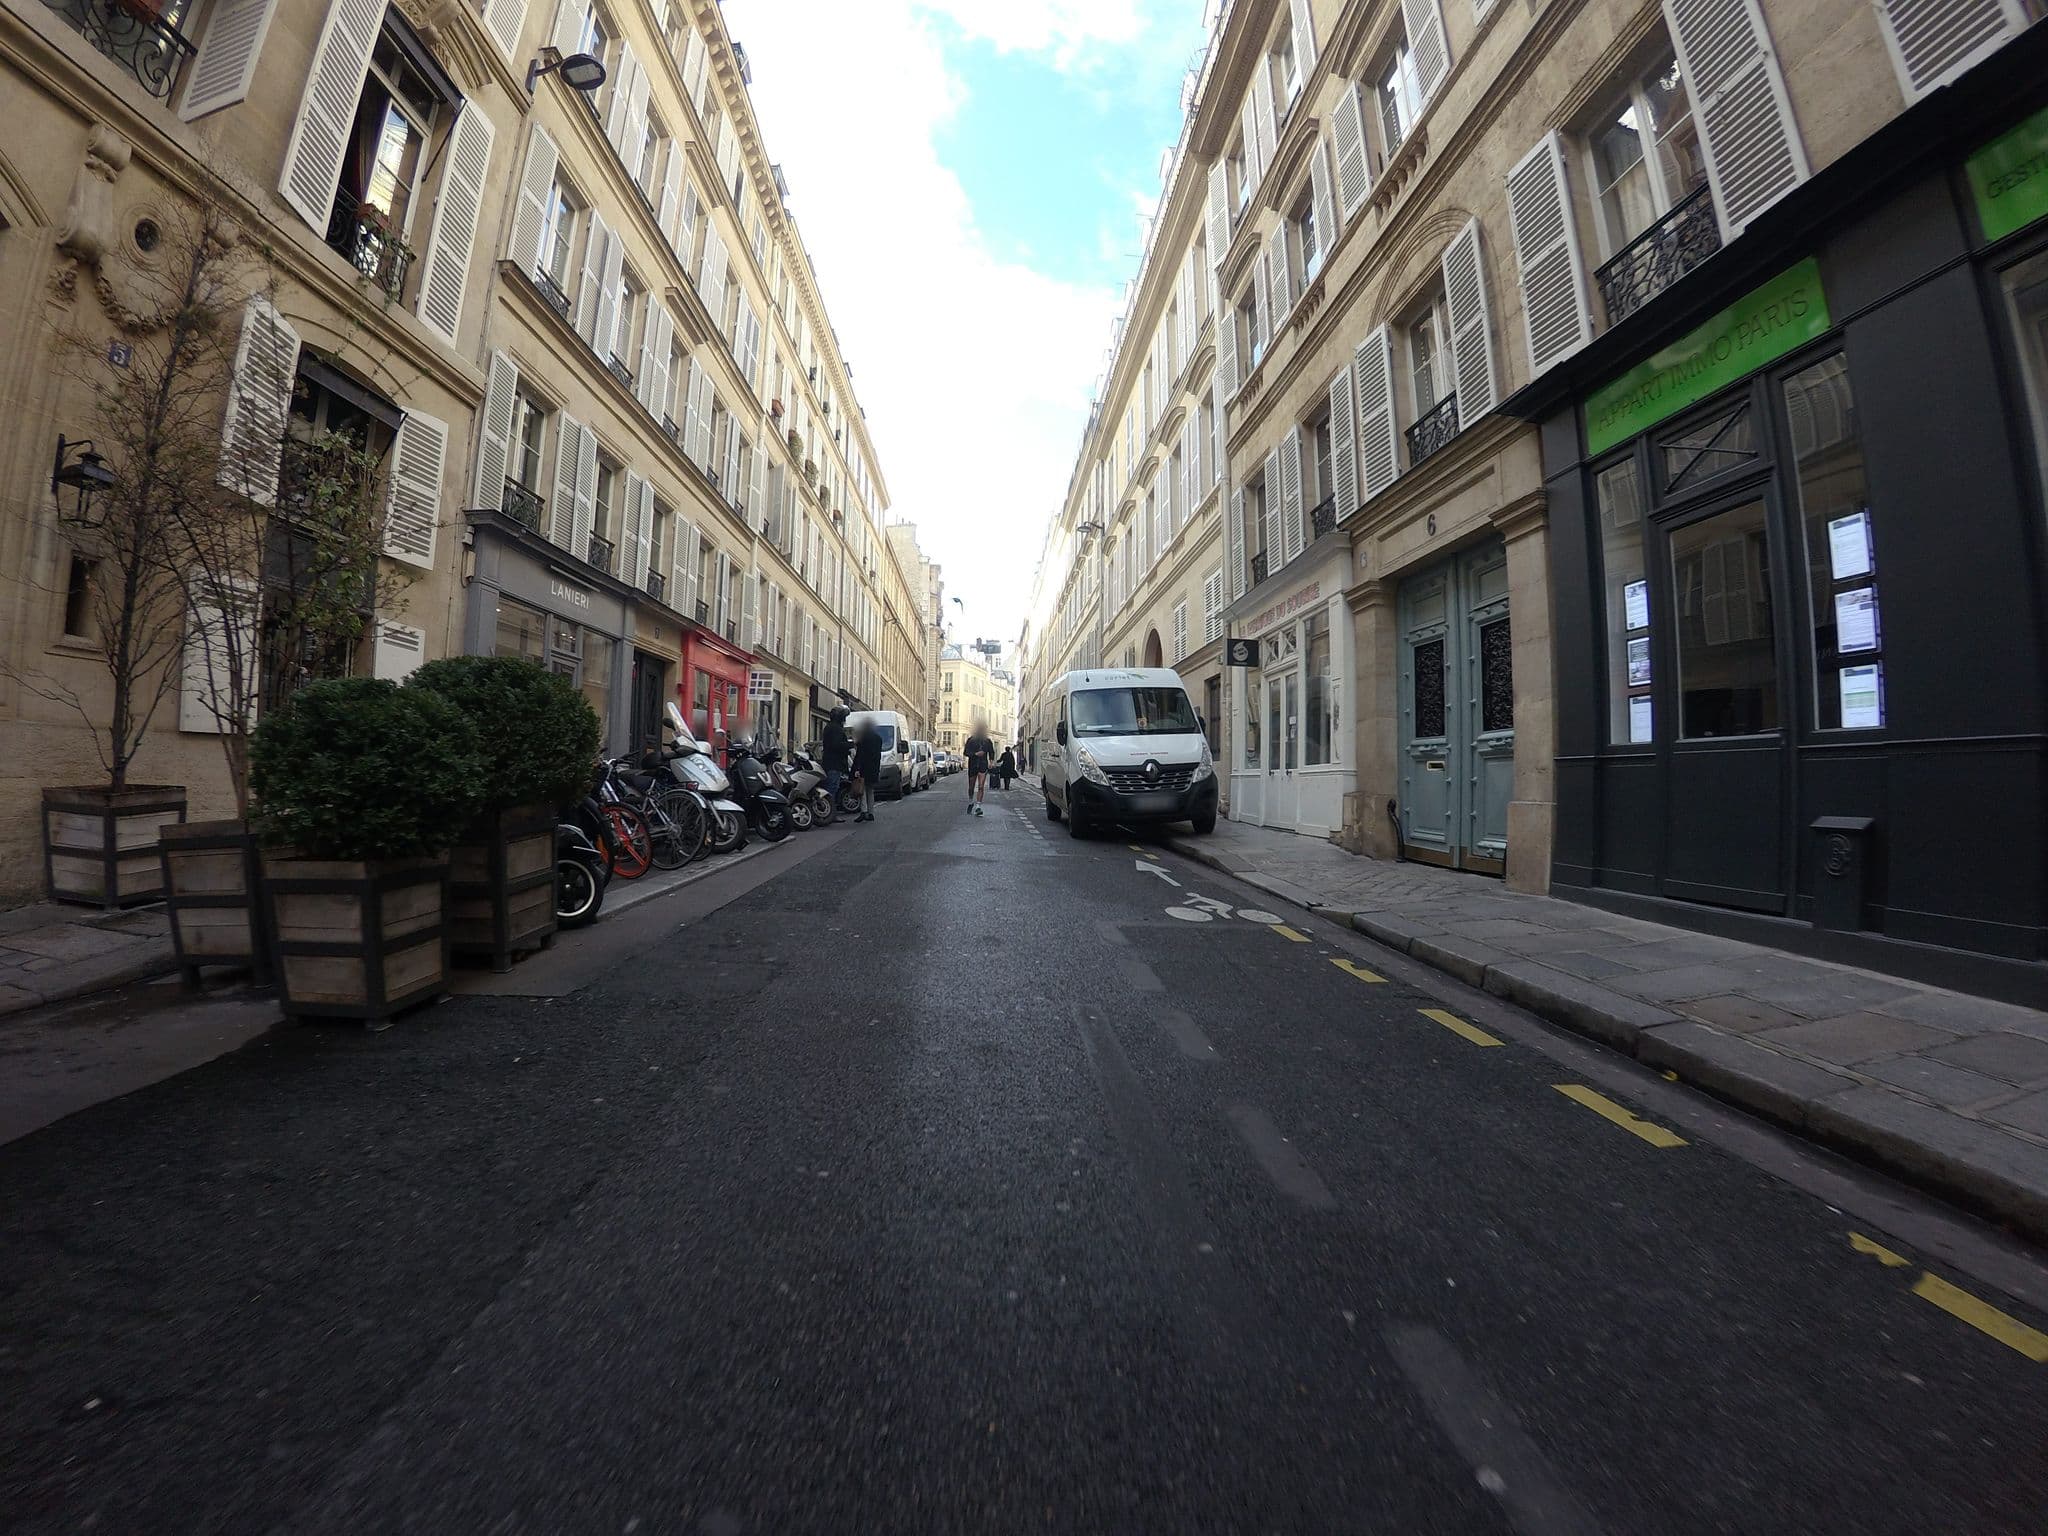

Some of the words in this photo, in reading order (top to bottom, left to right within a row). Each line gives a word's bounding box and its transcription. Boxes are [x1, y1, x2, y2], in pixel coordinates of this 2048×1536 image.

[114, 342, 127, 365] 5
[1598, 373, 1664, 433] APPART
[1671, 335, 1732, 390] IMMO
[1736, 288, 1809, 351] PARIS
[1427, 513, 1437, 537] 6
[551, 580, 590, 610] LANIERI
